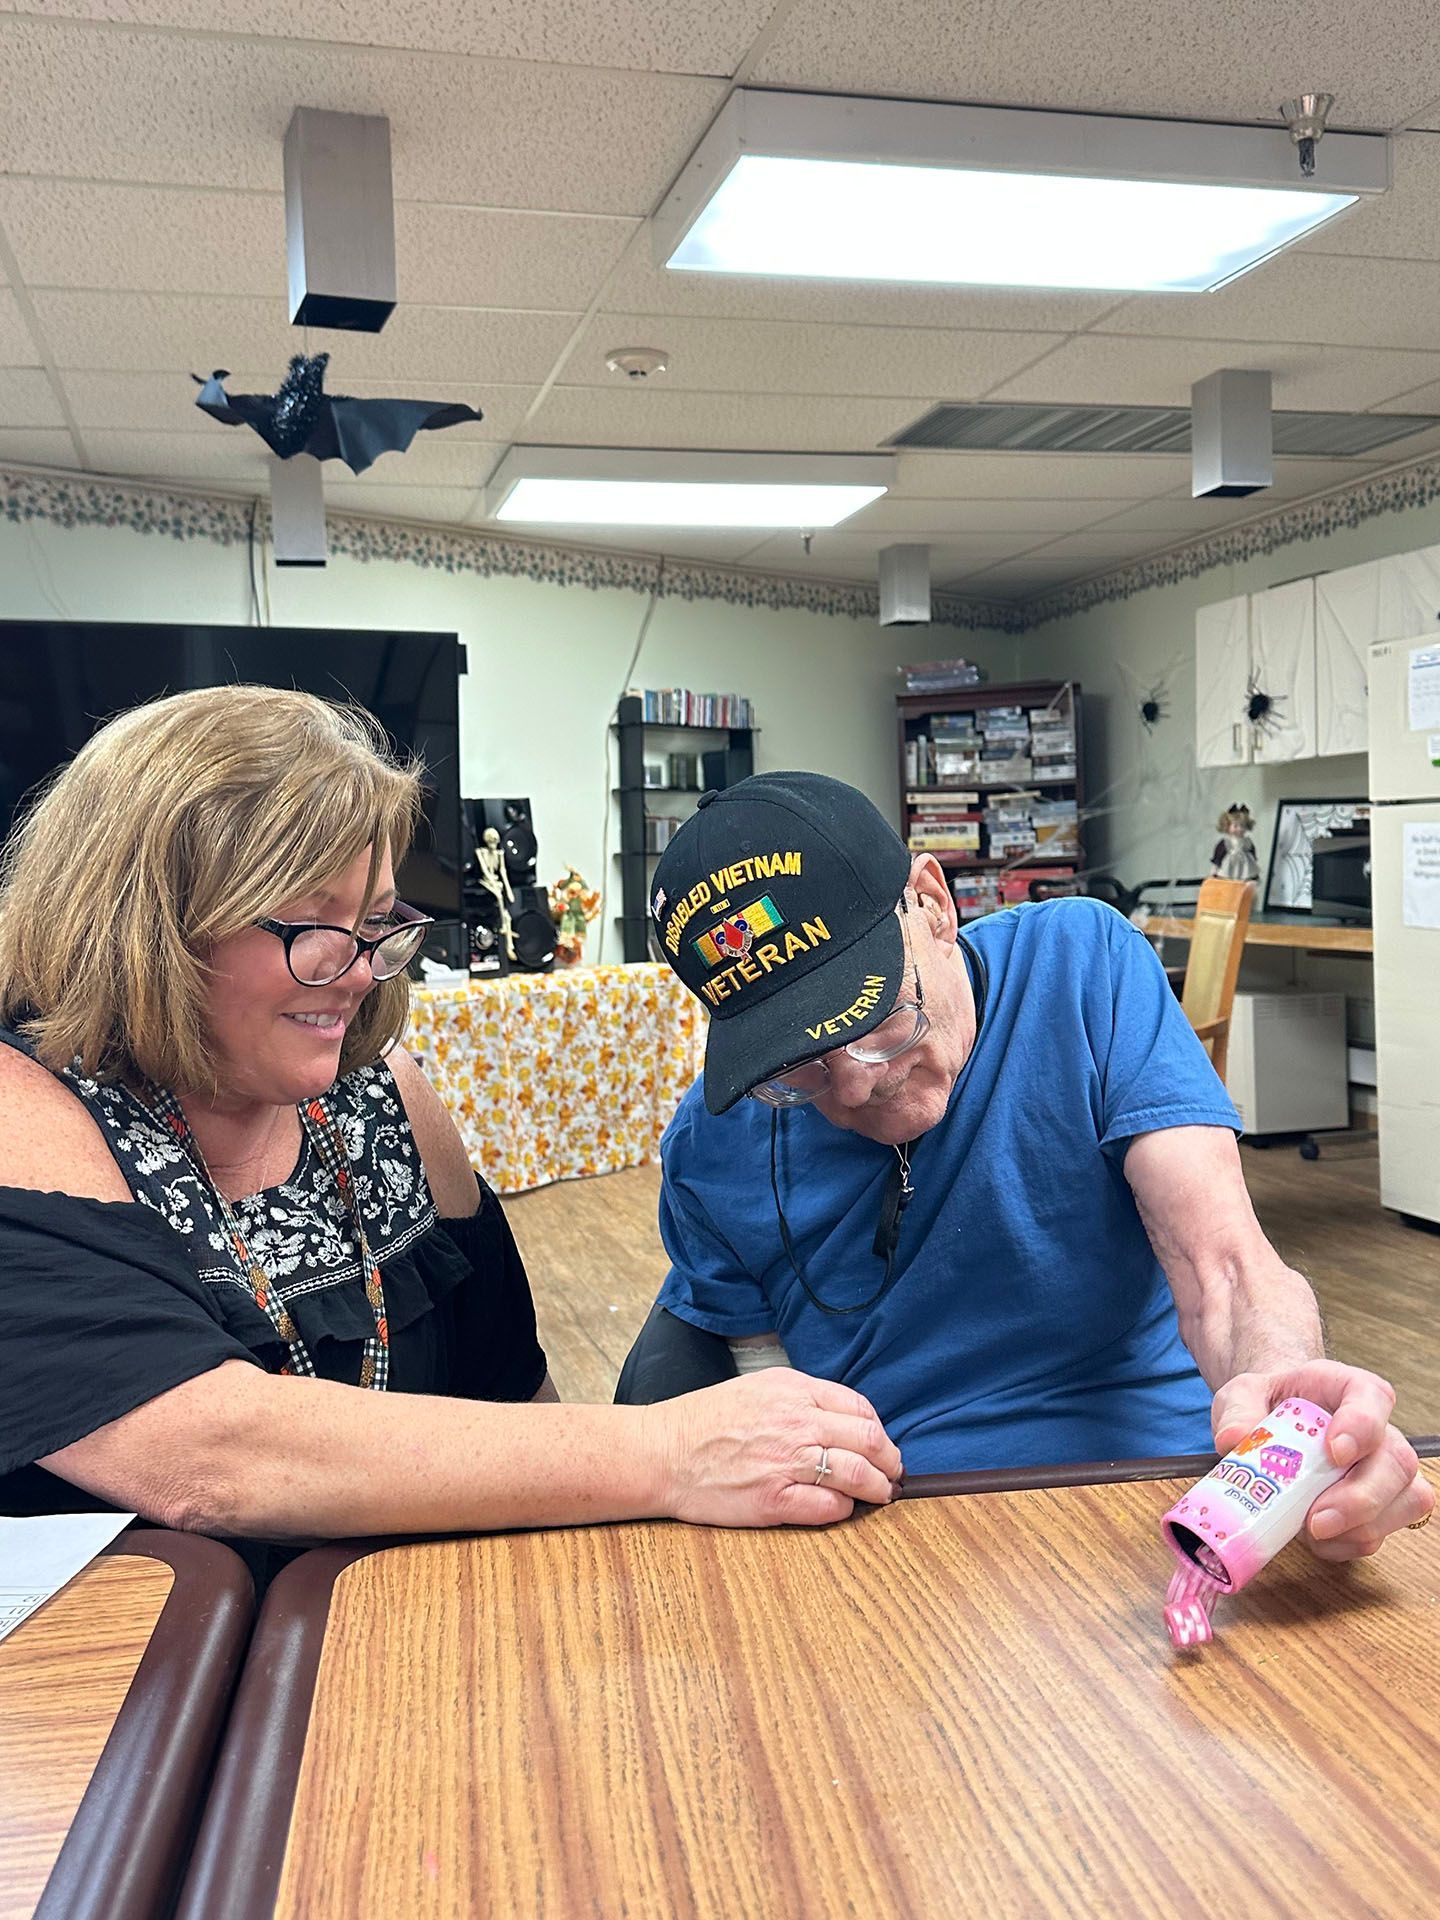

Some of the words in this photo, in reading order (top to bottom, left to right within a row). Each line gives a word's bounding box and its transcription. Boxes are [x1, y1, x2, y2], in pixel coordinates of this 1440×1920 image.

[664, 881, 712, 956] DISABLED
[710, 852, 802, 895] VIETNAM
[701, 916, 832, 1006] VETERAN
[805, 975, 887, 1040] VETERAN
